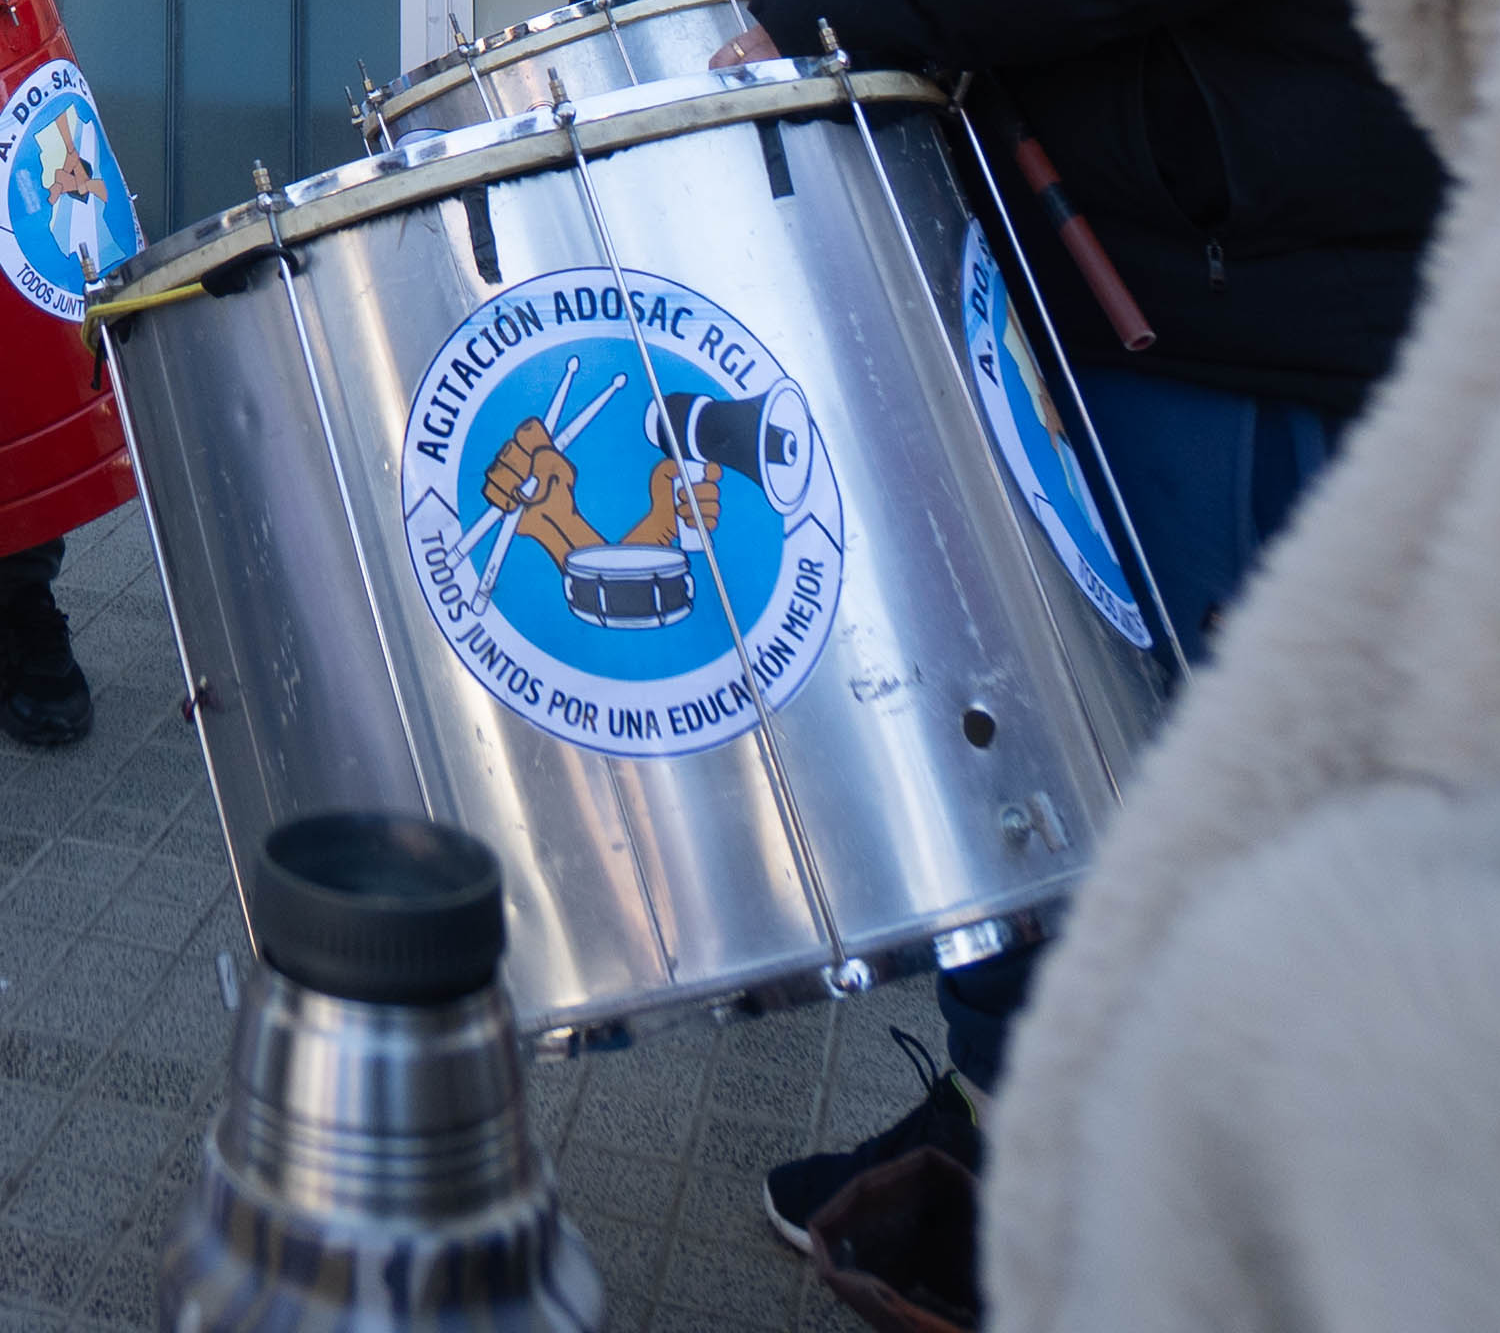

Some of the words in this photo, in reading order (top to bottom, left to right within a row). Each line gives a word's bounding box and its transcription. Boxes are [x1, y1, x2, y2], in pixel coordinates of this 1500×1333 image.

[16, 263, 54, 304] TODOS
[52, 293, 87, 317] JUNT
[416, 300, 545, 465] AGITACIÓN
[553, 285, 694, 340] ADOSAC
[697, 324, 756, 391] RGL
[421, 529, 474, 623] TODOS
[457, 621, 544, 707] JUNTOS
[547, 690, 599, 732] POR
[608, 707, 661, 740] UNA
[784, 556, 825, 649] MEJOR
